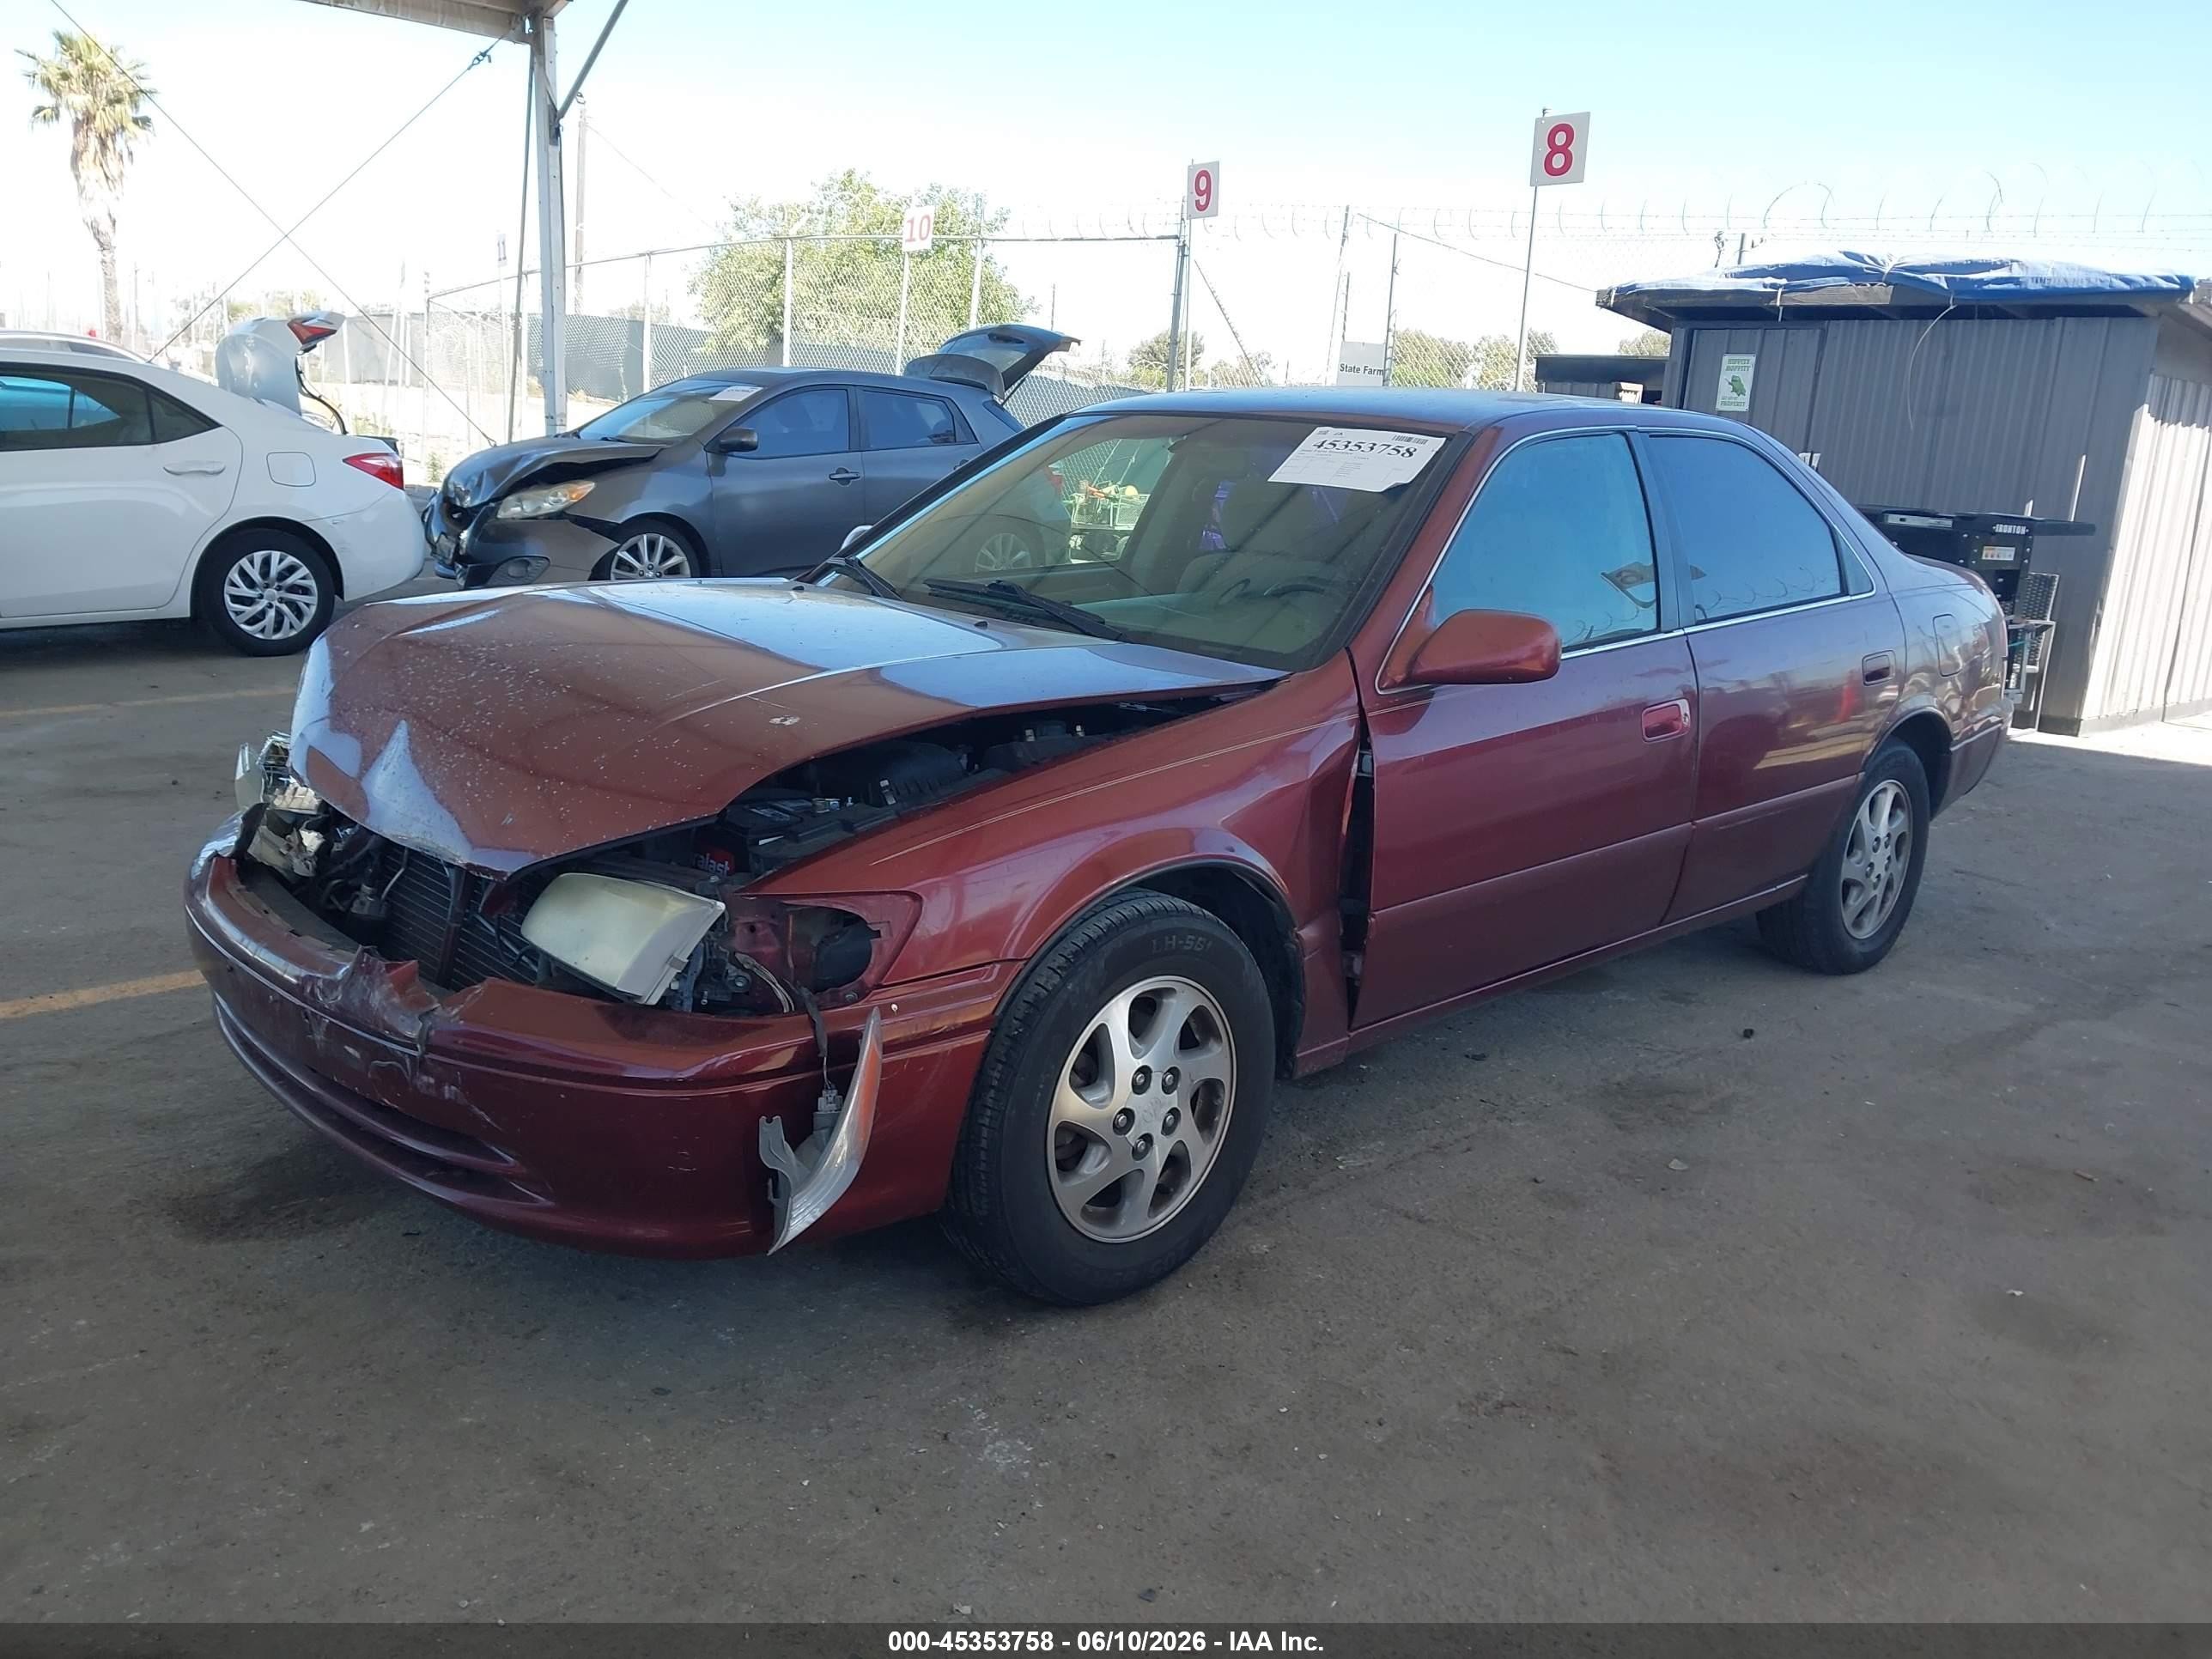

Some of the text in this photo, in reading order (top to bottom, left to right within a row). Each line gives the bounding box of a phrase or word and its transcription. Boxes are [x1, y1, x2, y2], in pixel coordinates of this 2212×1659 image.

[1544, 123, 1575, 177] 8
[1194, 169, 1212, 212] 9
[904, 214, 931, 242] 10
[1340, 363, 1384, 375] State Farm
[1313, 439, 1418, 459] 45353758
